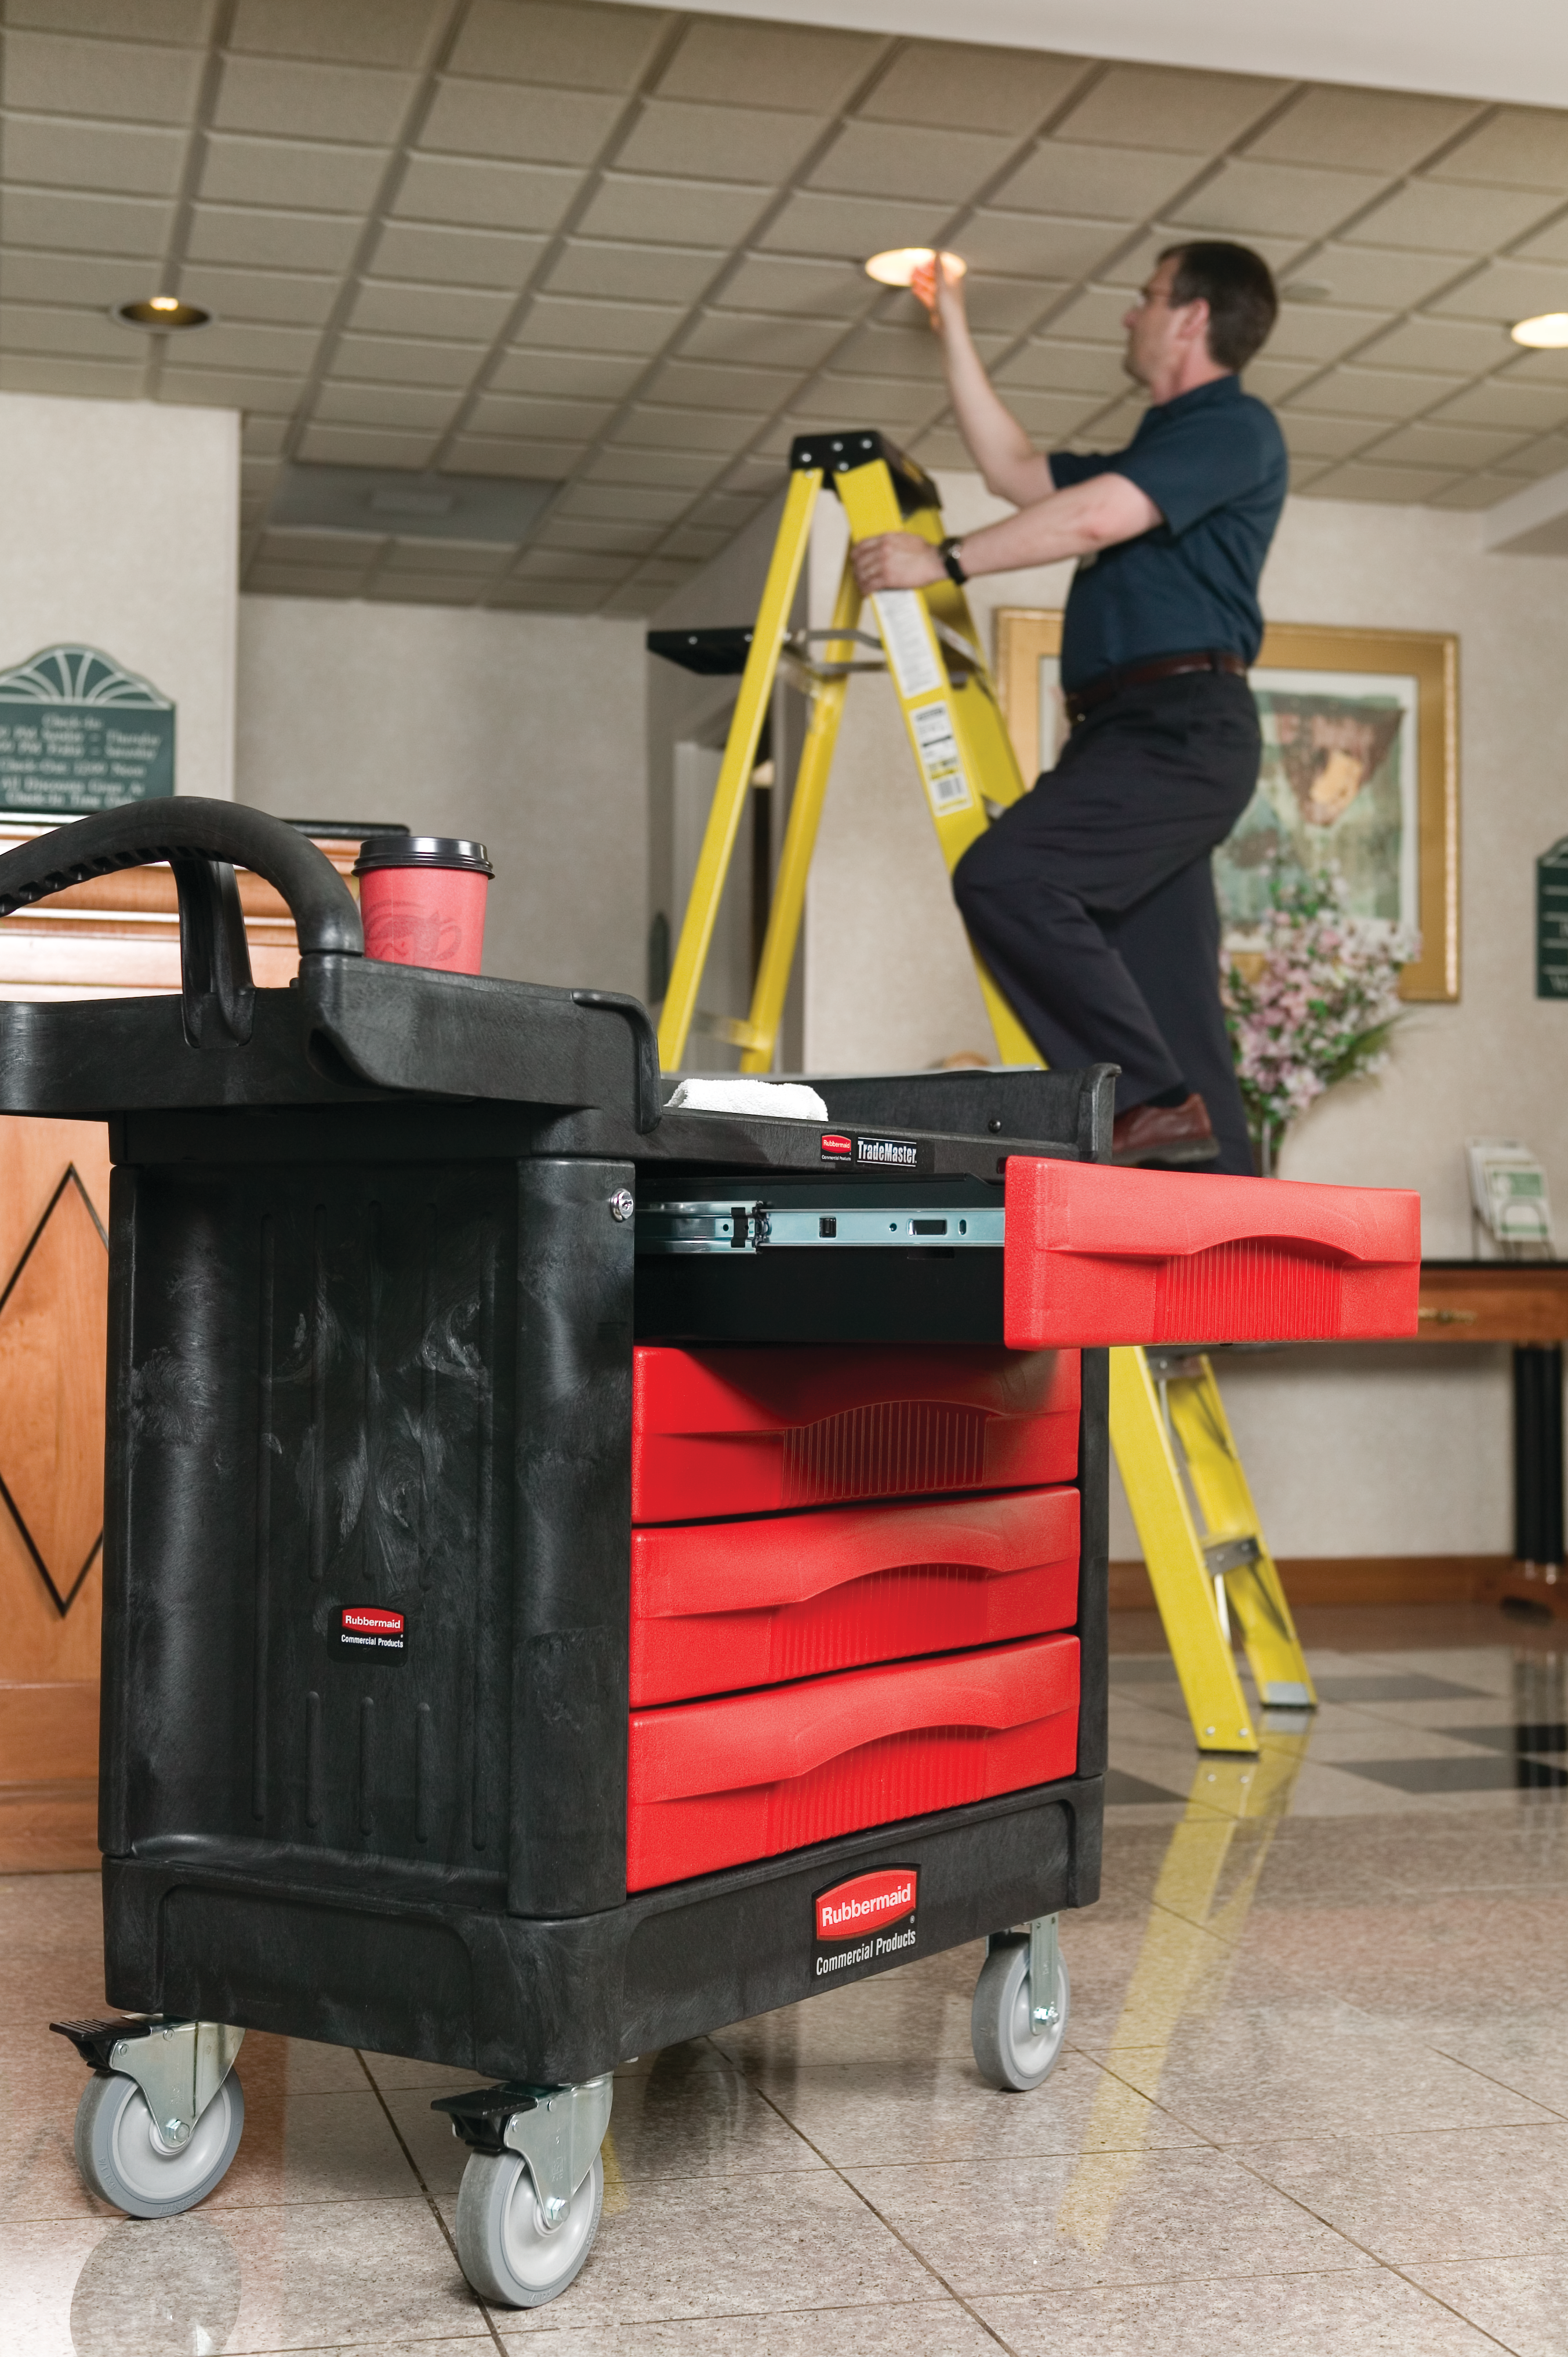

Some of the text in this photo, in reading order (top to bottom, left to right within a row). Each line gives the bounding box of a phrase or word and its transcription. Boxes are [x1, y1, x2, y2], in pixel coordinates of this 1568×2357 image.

[823, 1140, 850, 1148] Rubbermaid
[345, 1615, 401, 1629] Rubbermaid
[341, 1634, 404, 1648] Commercial Products
[822, 1883, 911, 1927] Rubbermaid
[816, 1929, 916, 1976] Commercial Products
